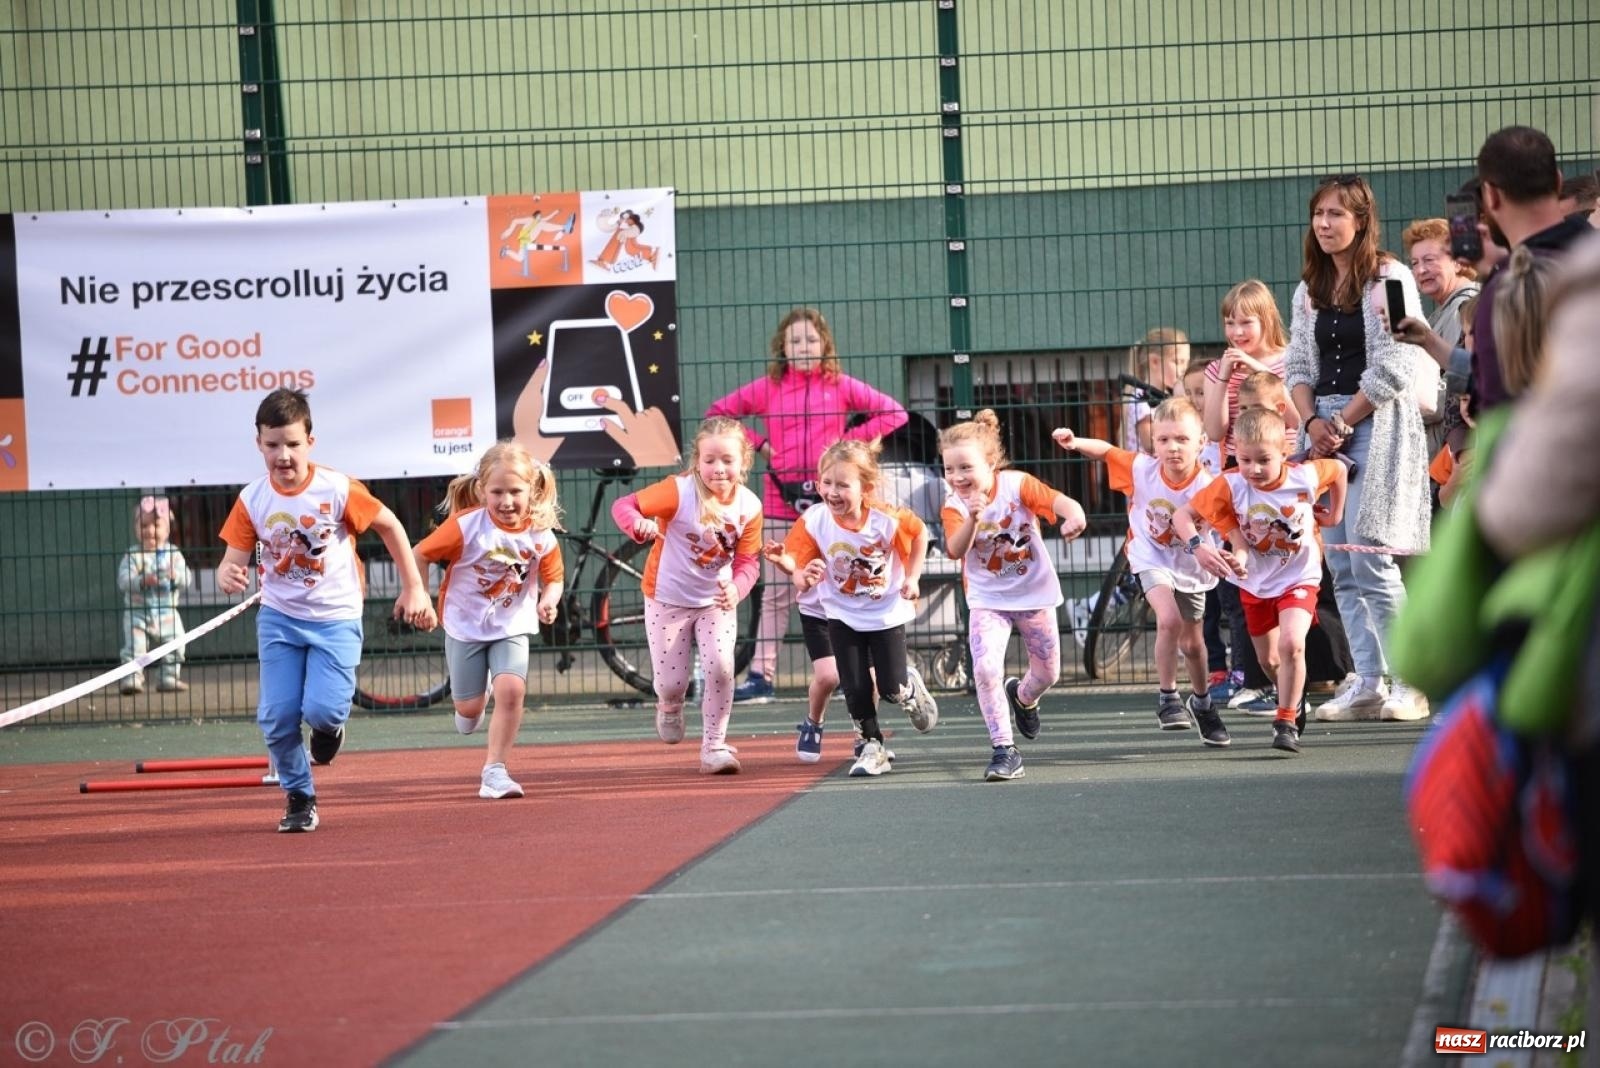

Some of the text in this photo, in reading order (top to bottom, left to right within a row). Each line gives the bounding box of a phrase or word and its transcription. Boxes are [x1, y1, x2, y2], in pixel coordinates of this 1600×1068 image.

[60, 264, 449, 310] Nie przescrolluj życia
[67, 332, 262, 397] # For Good
[116, 366, 315, 395] Connections
[567, 393, 585, 402] OFF
[434, 427, 469, 438] orange
[433, 441, 472, 456] tu jest
